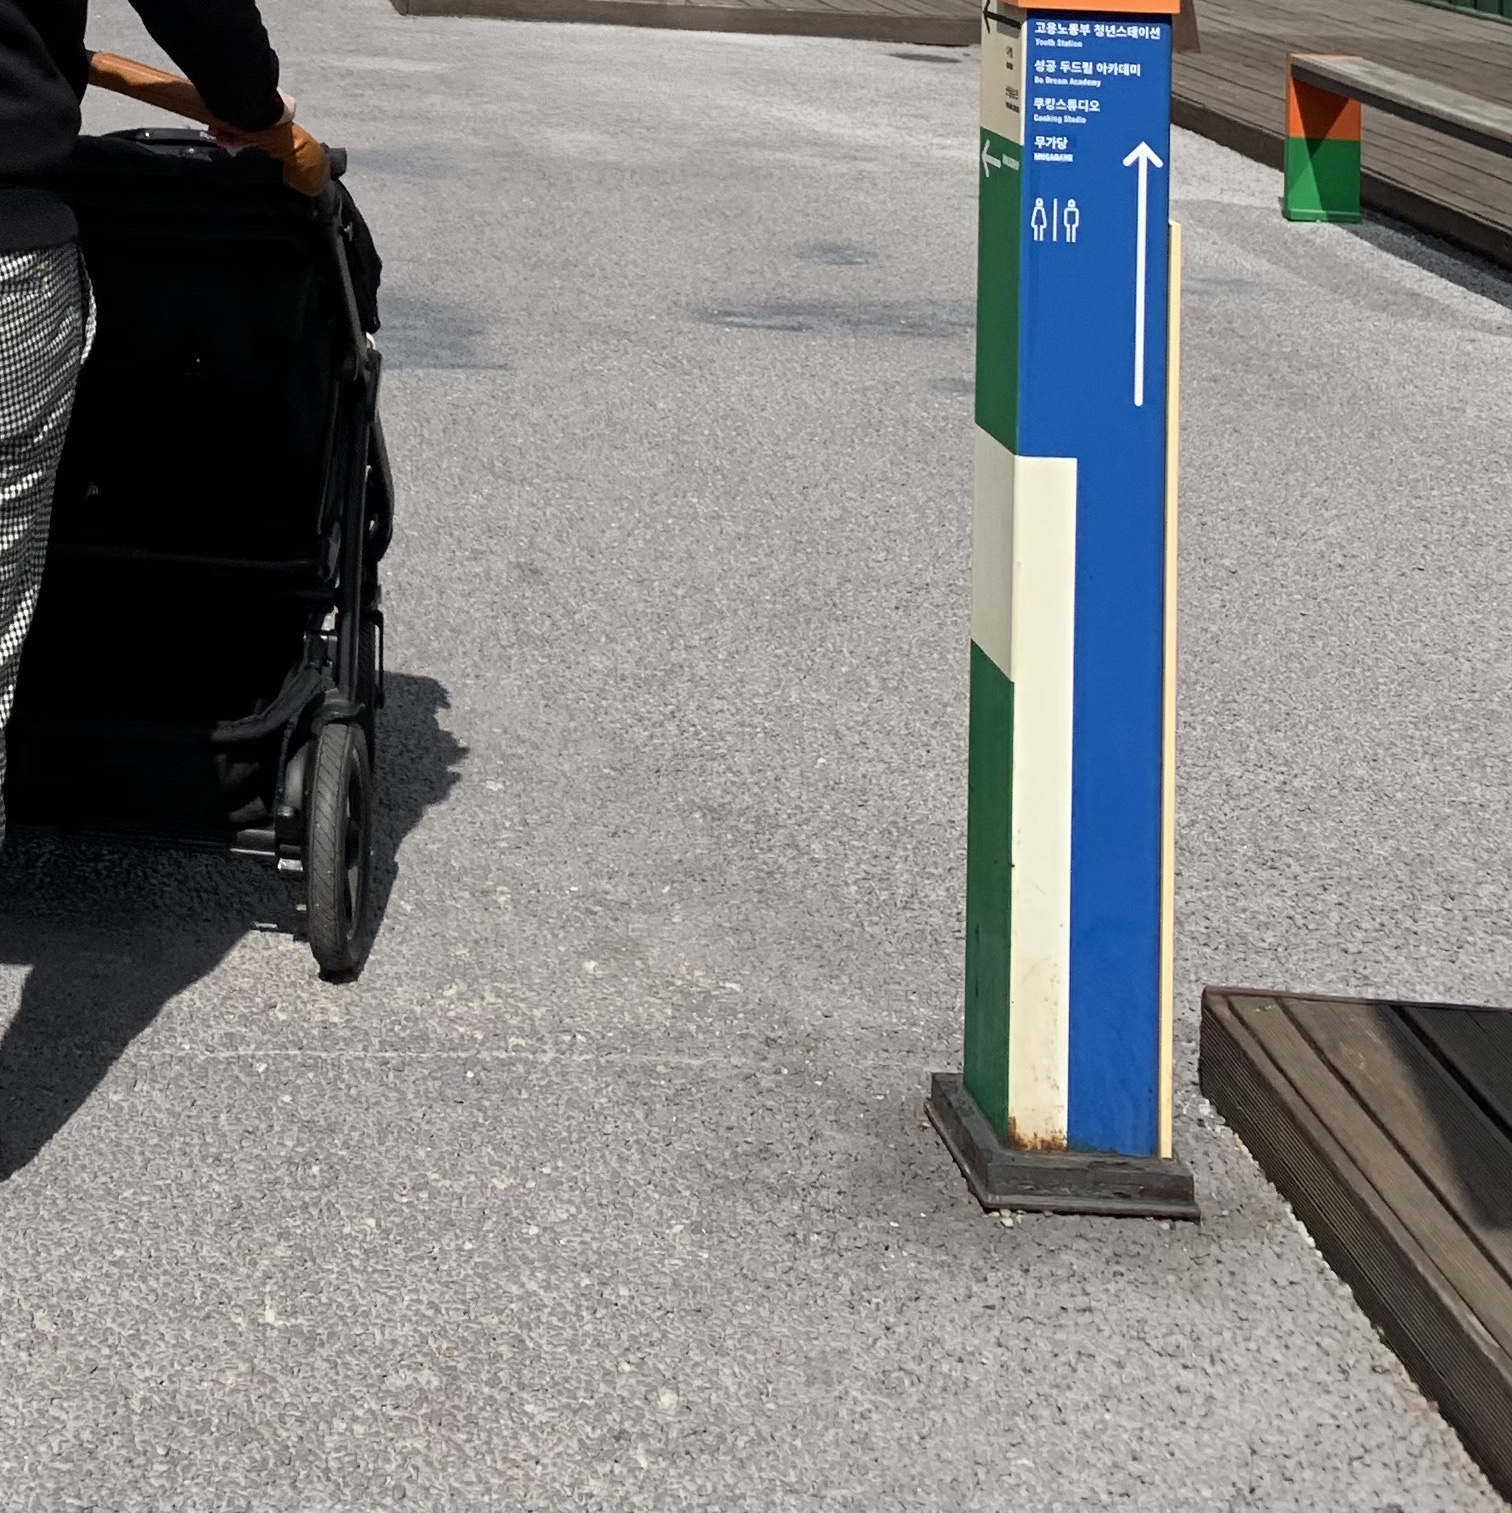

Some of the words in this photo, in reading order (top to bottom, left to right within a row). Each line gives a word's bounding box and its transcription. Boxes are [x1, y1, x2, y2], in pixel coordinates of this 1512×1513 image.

[1034, 21, 1091, 37] 고용노동부
[1093, 23, 1161, 40] 청년스테이션
[1034, 37, 1056, 48] Youth
[1056, 38, 1083, 48] Station
[1033, 59, 1057, 73] 성공
[1059, 60, 1093, 75] 두드림
[1095, 61, 1141, 77] 아카데미
[1033, 75, 1045, 84] Do
[1045, 76, 1069, 85] Dream
[1069, 77, 1102, 88] Academy
[1033, 97, 1101, 113] 쿠킹스튜디오
[1033, 113, 1063, 124] Cooking
[1063, 114, 1087, 124] Studio
[1033, 135, 1069, 151] 무가당
